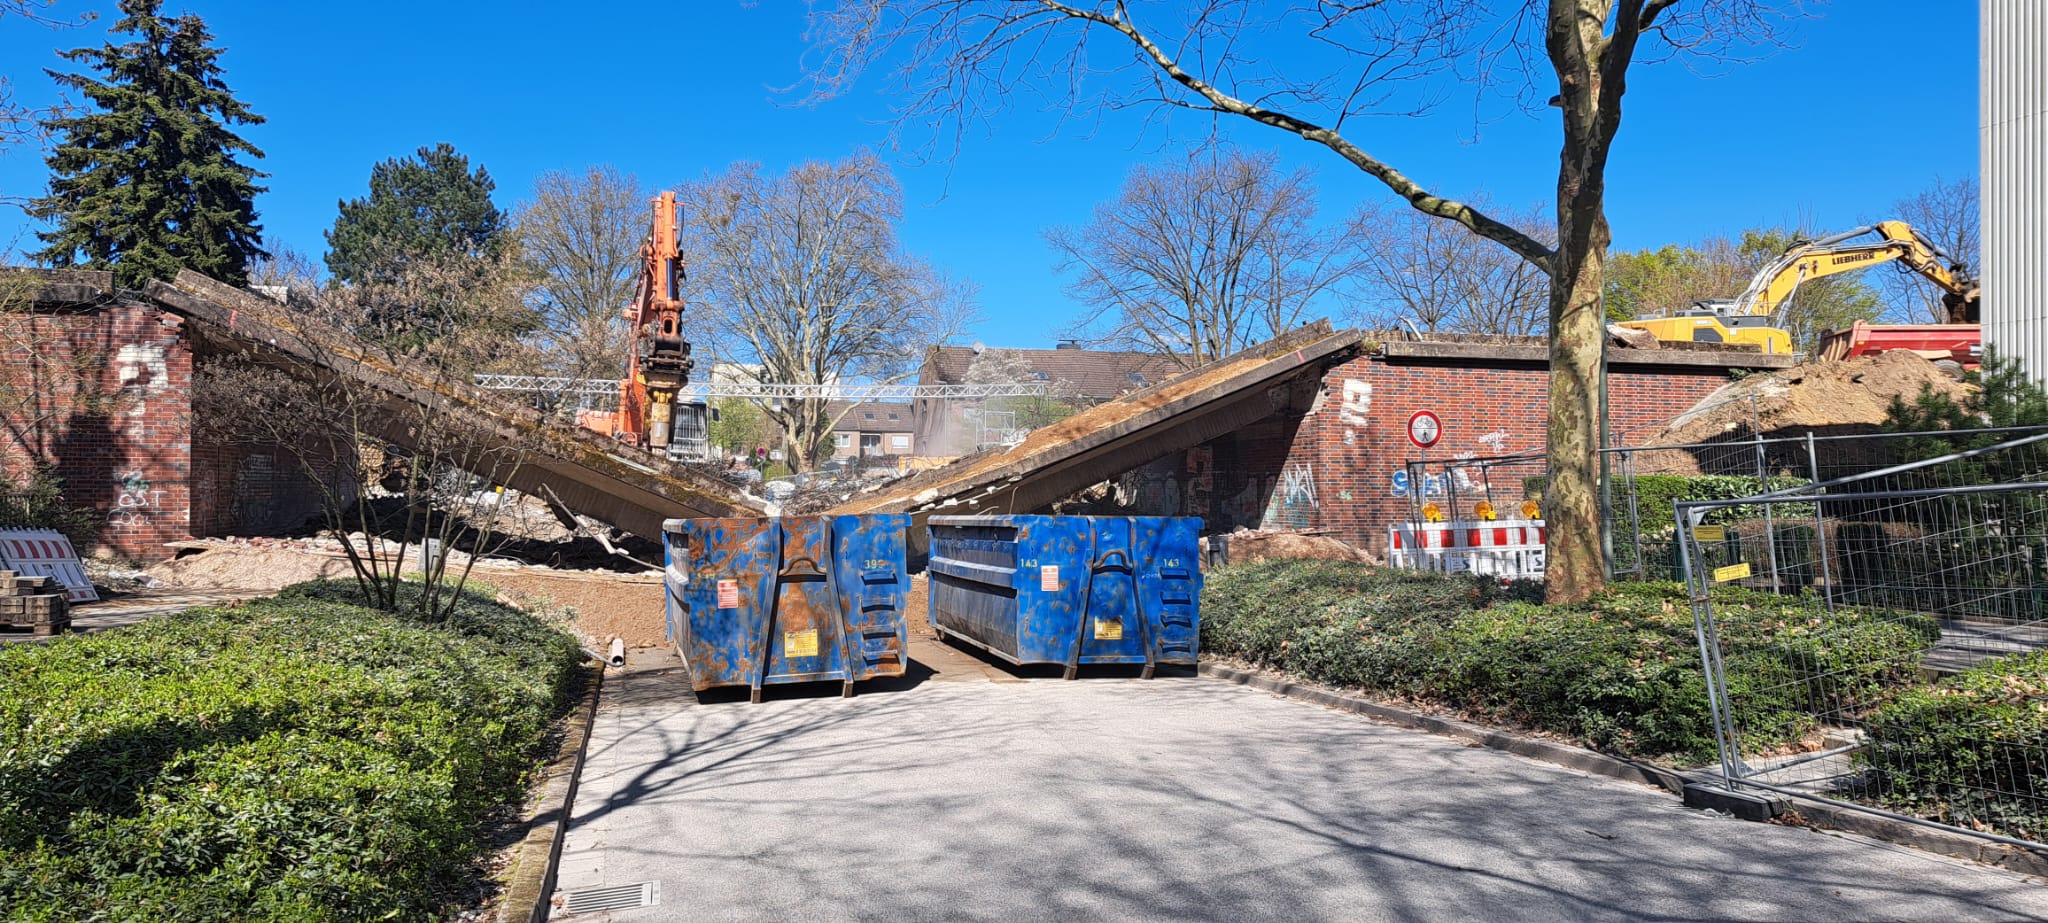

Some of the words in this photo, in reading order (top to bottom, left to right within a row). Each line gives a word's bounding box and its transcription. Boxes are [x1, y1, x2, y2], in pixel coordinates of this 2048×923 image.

[1831, 251, 1875, 265] LIEBHERR
[1020, 558, 1038, 569] 143
[1163, 558, 1180, 569] 143
